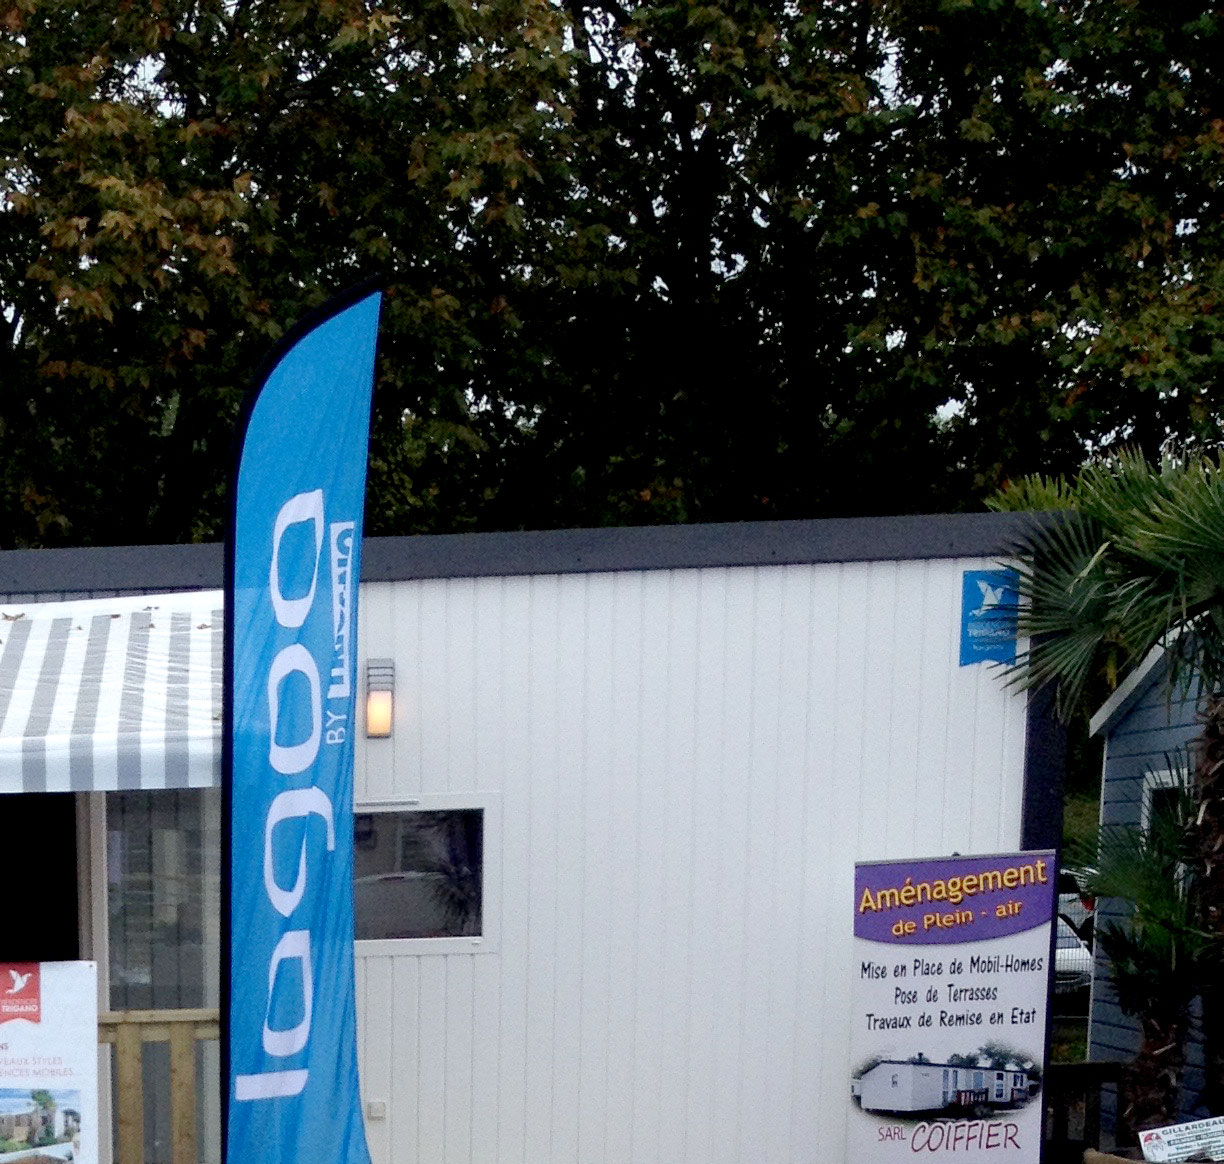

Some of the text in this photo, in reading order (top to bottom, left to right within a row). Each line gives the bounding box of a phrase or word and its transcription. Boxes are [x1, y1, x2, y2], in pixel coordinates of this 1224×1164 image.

[326, 709, 348, 745] BY
[859, 859, 1049, 914] Aménagement
[891, 920, 917, 937] de
[923, 909, 974, 930] Plein
[995, 900, 1023, 918] air
[860, 954, 1044, 980] Mise en Place de Mobil-Homes
[894, 983, 998, 1005] Pose de Terrasses
[865, 1007, 1037, 1031] Travaux de Remise en Etat
[877, 1121, 1022, 1153] SARL COIFFIER
